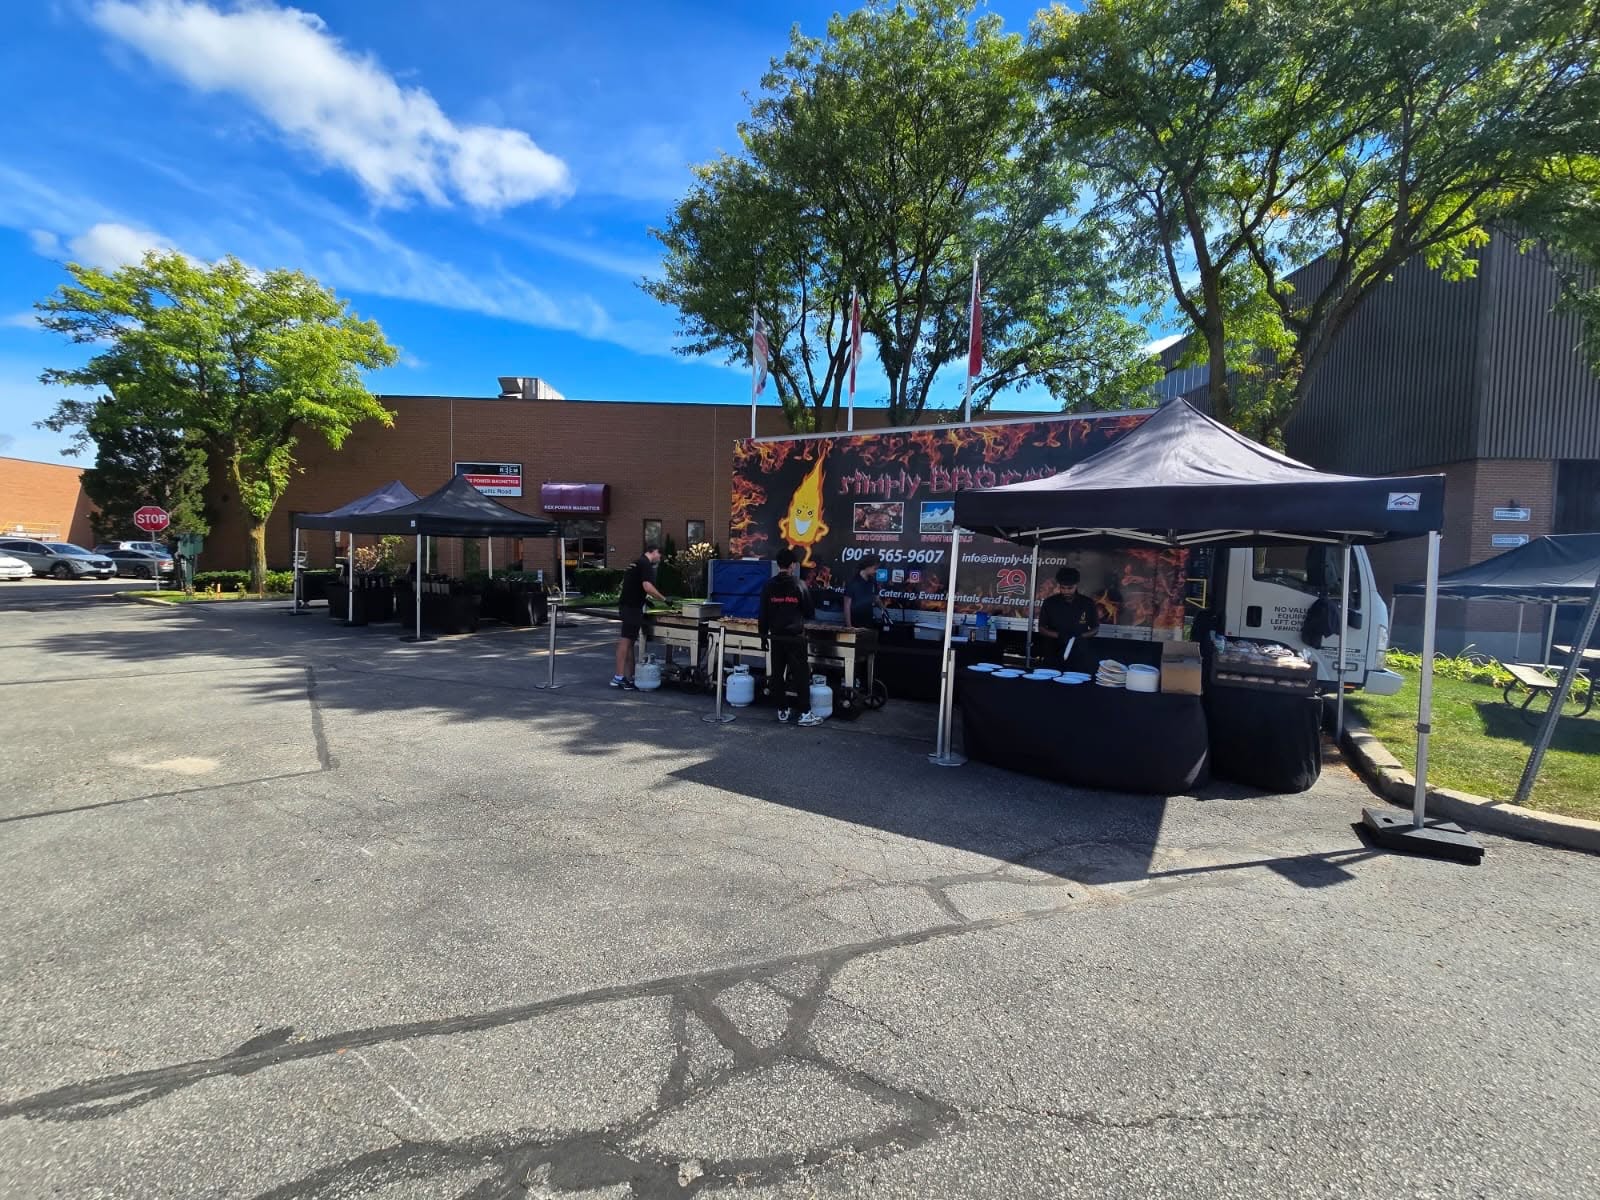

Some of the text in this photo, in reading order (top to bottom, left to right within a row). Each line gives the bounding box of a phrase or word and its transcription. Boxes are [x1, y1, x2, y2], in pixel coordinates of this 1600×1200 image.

[137, 514, 167, 524] STOP
[878, 549, 944, 563] 565-9607
[997, 569, 1026, 588] 20
[879, 589, 917, 600] Caterng,
[918, 591, 944, 600] Event
[982, 596, 1001, 604] and
